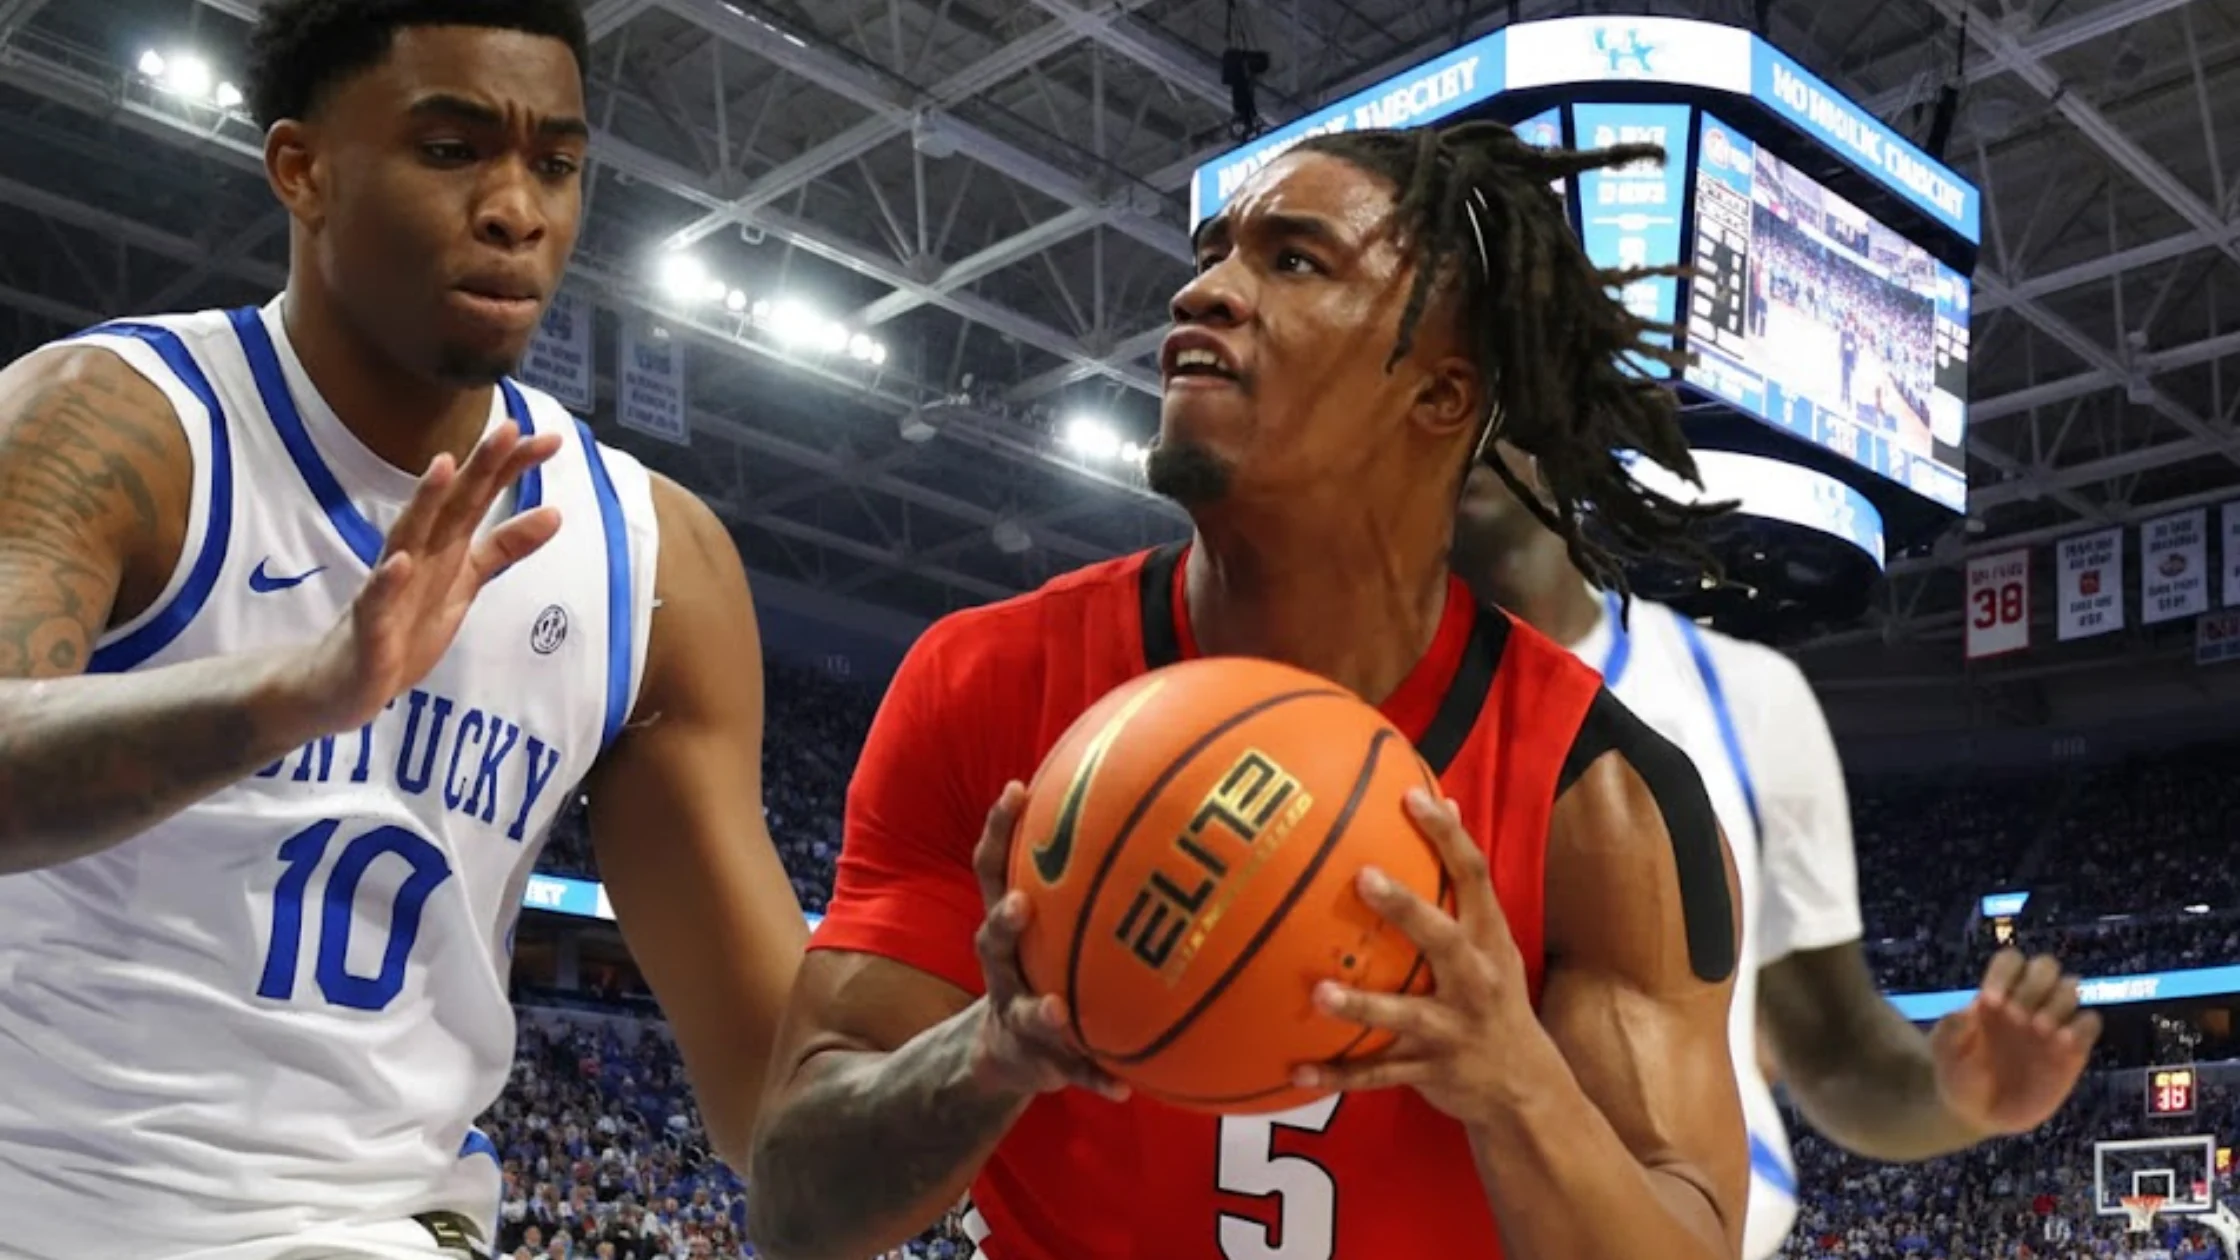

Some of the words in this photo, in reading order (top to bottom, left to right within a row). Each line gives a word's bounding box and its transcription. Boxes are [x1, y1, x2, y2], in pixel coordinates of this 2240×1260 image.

[1972, 582, 2024, 630] 38
[256, 817, 453, 1012] 10
[1114, 748, 1300, 971] ELITE
[1214, 1091, 1346, 1260] 5
